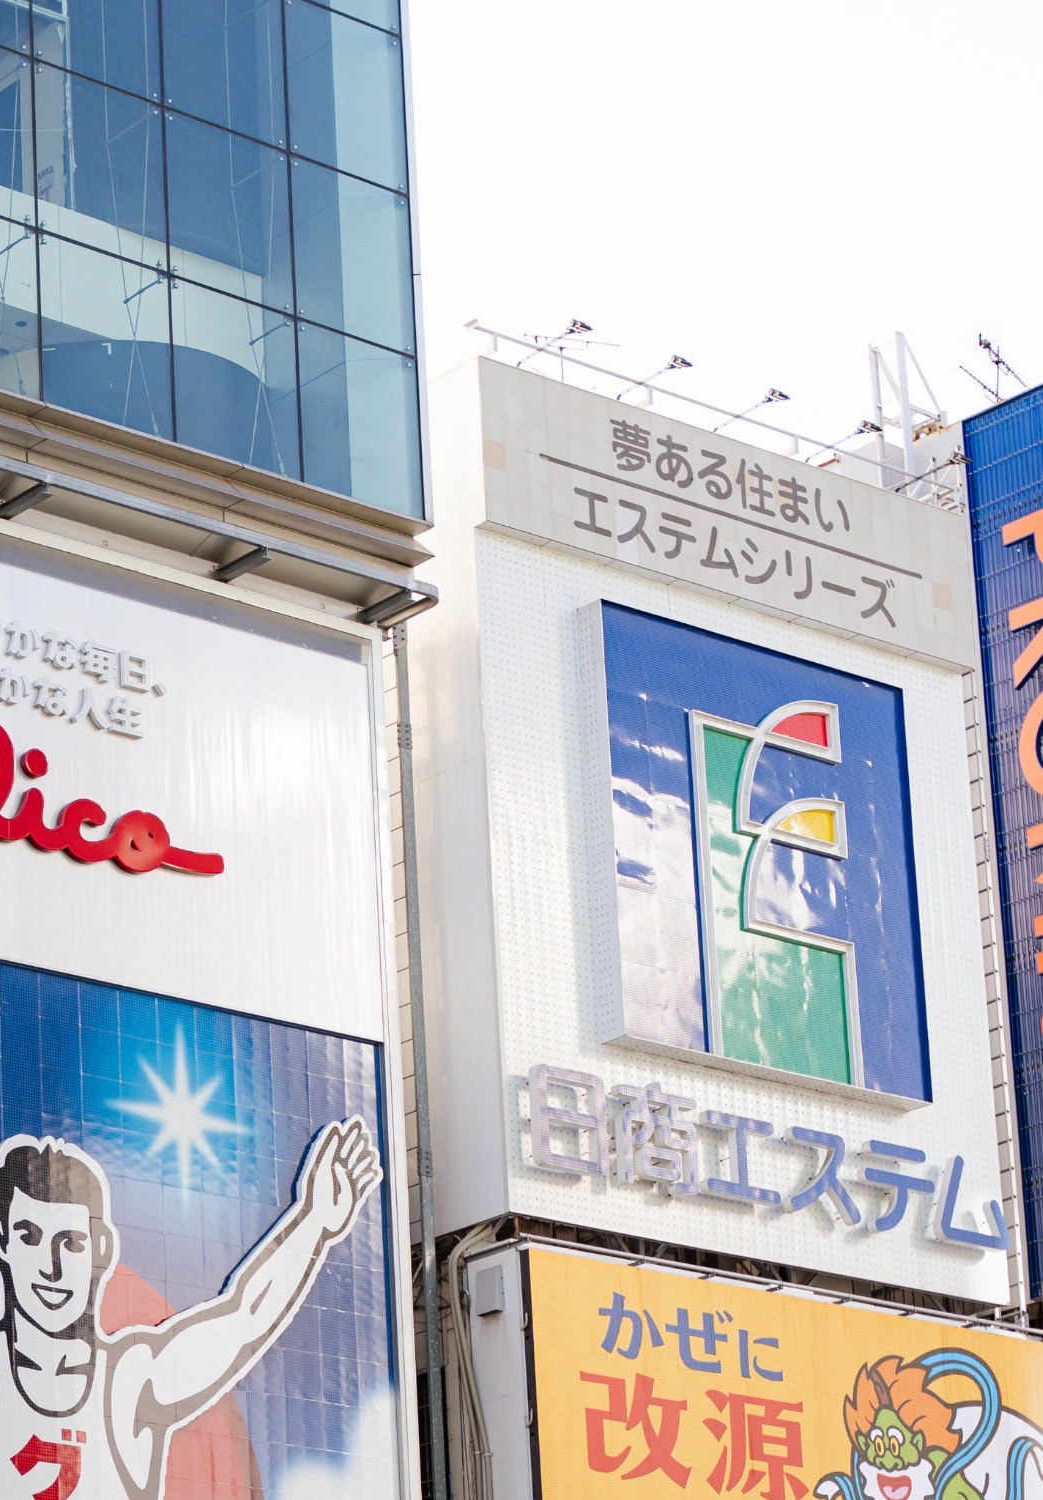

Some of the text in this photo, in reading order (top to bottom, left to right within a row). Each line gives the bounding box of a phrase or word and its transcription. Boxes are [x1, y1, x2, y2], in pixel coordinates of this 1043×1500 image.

[610, 418, 850, 532] 夢ある住まい
[573, 487, 896, 628] エステムシリーズ
[529, 1062, 1011, 1251] 日商エステム
[598, 1291, 785, 1382] かぜに
